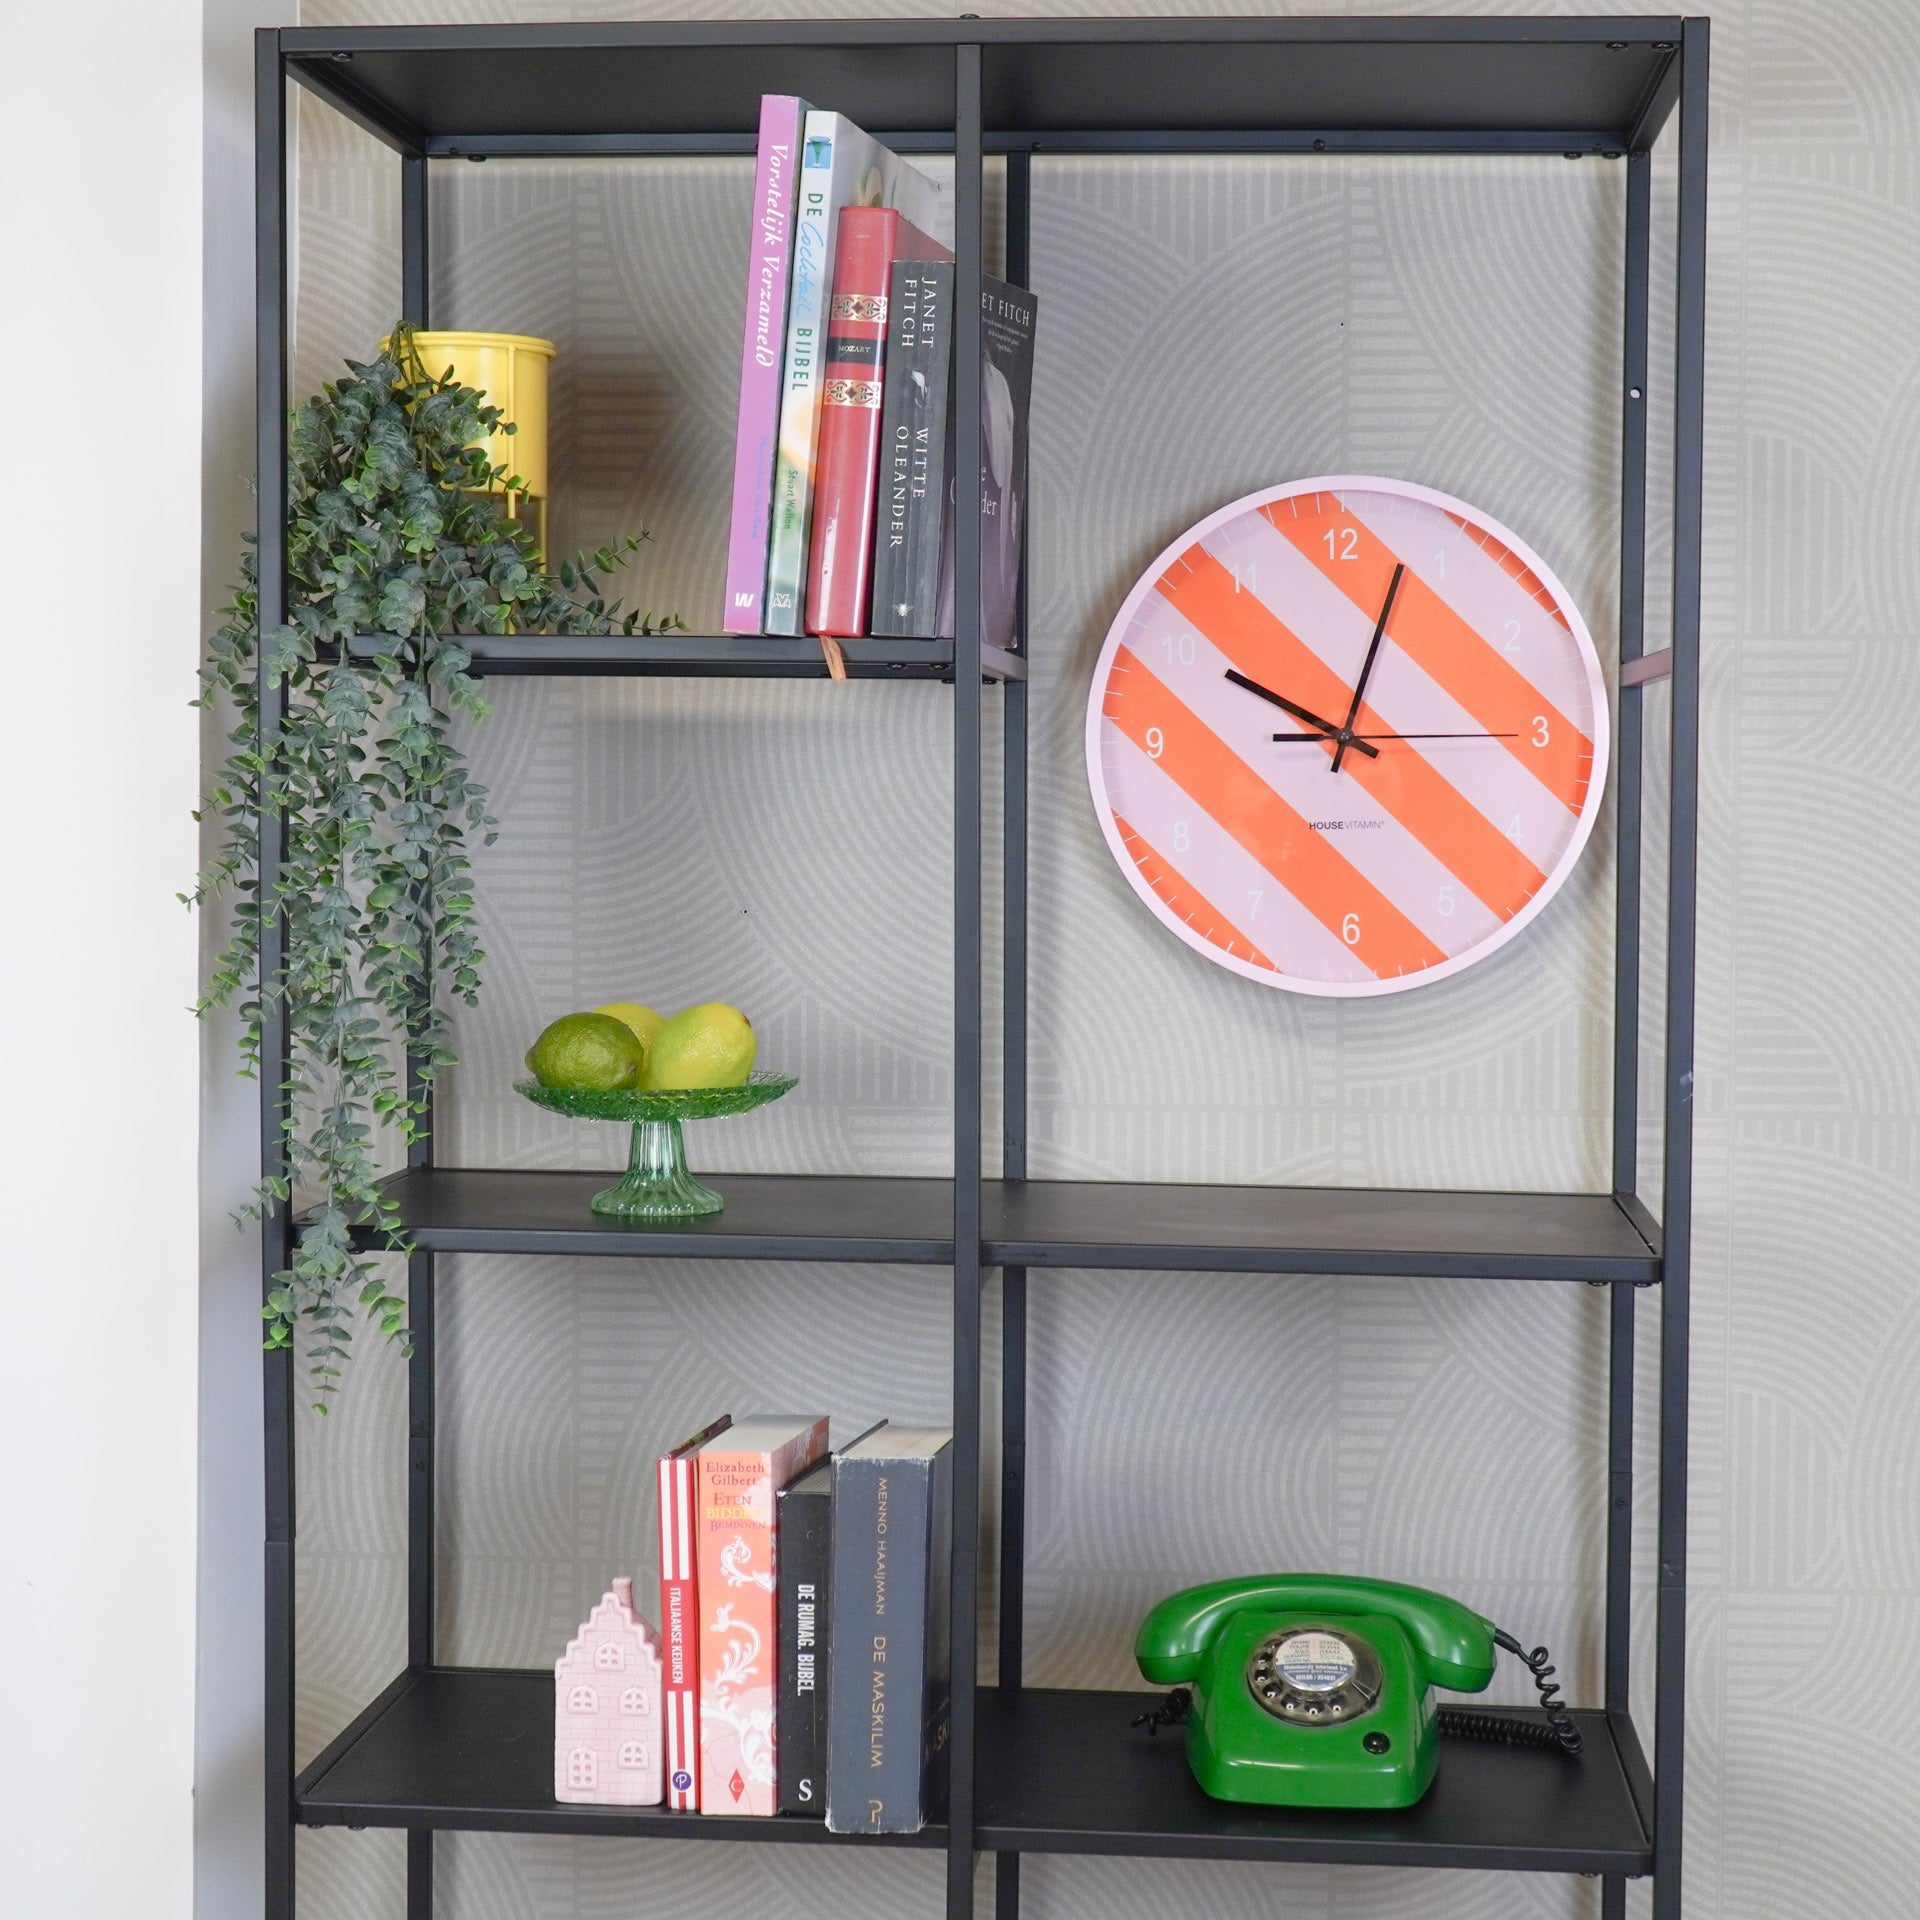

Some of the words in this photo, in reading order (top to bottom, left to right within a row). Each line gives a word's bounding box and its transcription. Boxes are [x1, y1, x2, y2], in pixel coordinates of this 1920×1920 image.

[761, 143, 789, 249] Vorstelijk
[806, 192, 824, 217] DE
[796, 220, 825, 320] Cocktail
[901, 279, 918, 347] FITCH
[921, 276, 938, 349] JANET
[998, 299, 1030, 327] FITCH
[791, 327, 813, 391] BIJBEL
[838, 345, 871, 353] MOZART
[912, 427, 929, 499] WITTE
[786, 469, 799, 497] Stuart
[889, 425, 909, 548] OLEANDER
[783, 499, 797, 530] Walton
[1323, 528, 1359, 560] 12
[1230, 562, 1258, 594] 11
[1434, 549, 1445, 580] 1
[1161, 633, 1196, 667] 10
[1504, 619, 1522, 652] 2
[1145, 726, 1164, 759] 9
[1531, 715, 1550, 748] 3
[1172, 821, 1191, 853] 8
[1506, 813, 1524, 844] 4
[1247, 890, 1264, 921] 7
[1437, 885, 1455, 917] 5
[1342, 913, 1361, 945] 6
[706, 1461, 764, 1473] Elizabeth
[711, 1474, 757, 1486] Gilbert
[877, 1477, 888, 1535] MENNO
[797, 1584, 815, 1600] DE
[873, 1540, 886, 1615] HAAIJMAN
[669, 1587, 683, 1644] ITALIAANSE
[797, 1603, 815, 1651] RUMAG.
[671, 1645, 684, 1684] KEUKEN
[873, 1636, 886, 1663] DE
[797, 1653, 815, 1697] BIJBEL.
[870, 1670, 885, 1768] MASKILIM
[798, 1778, 813, 1801] S
